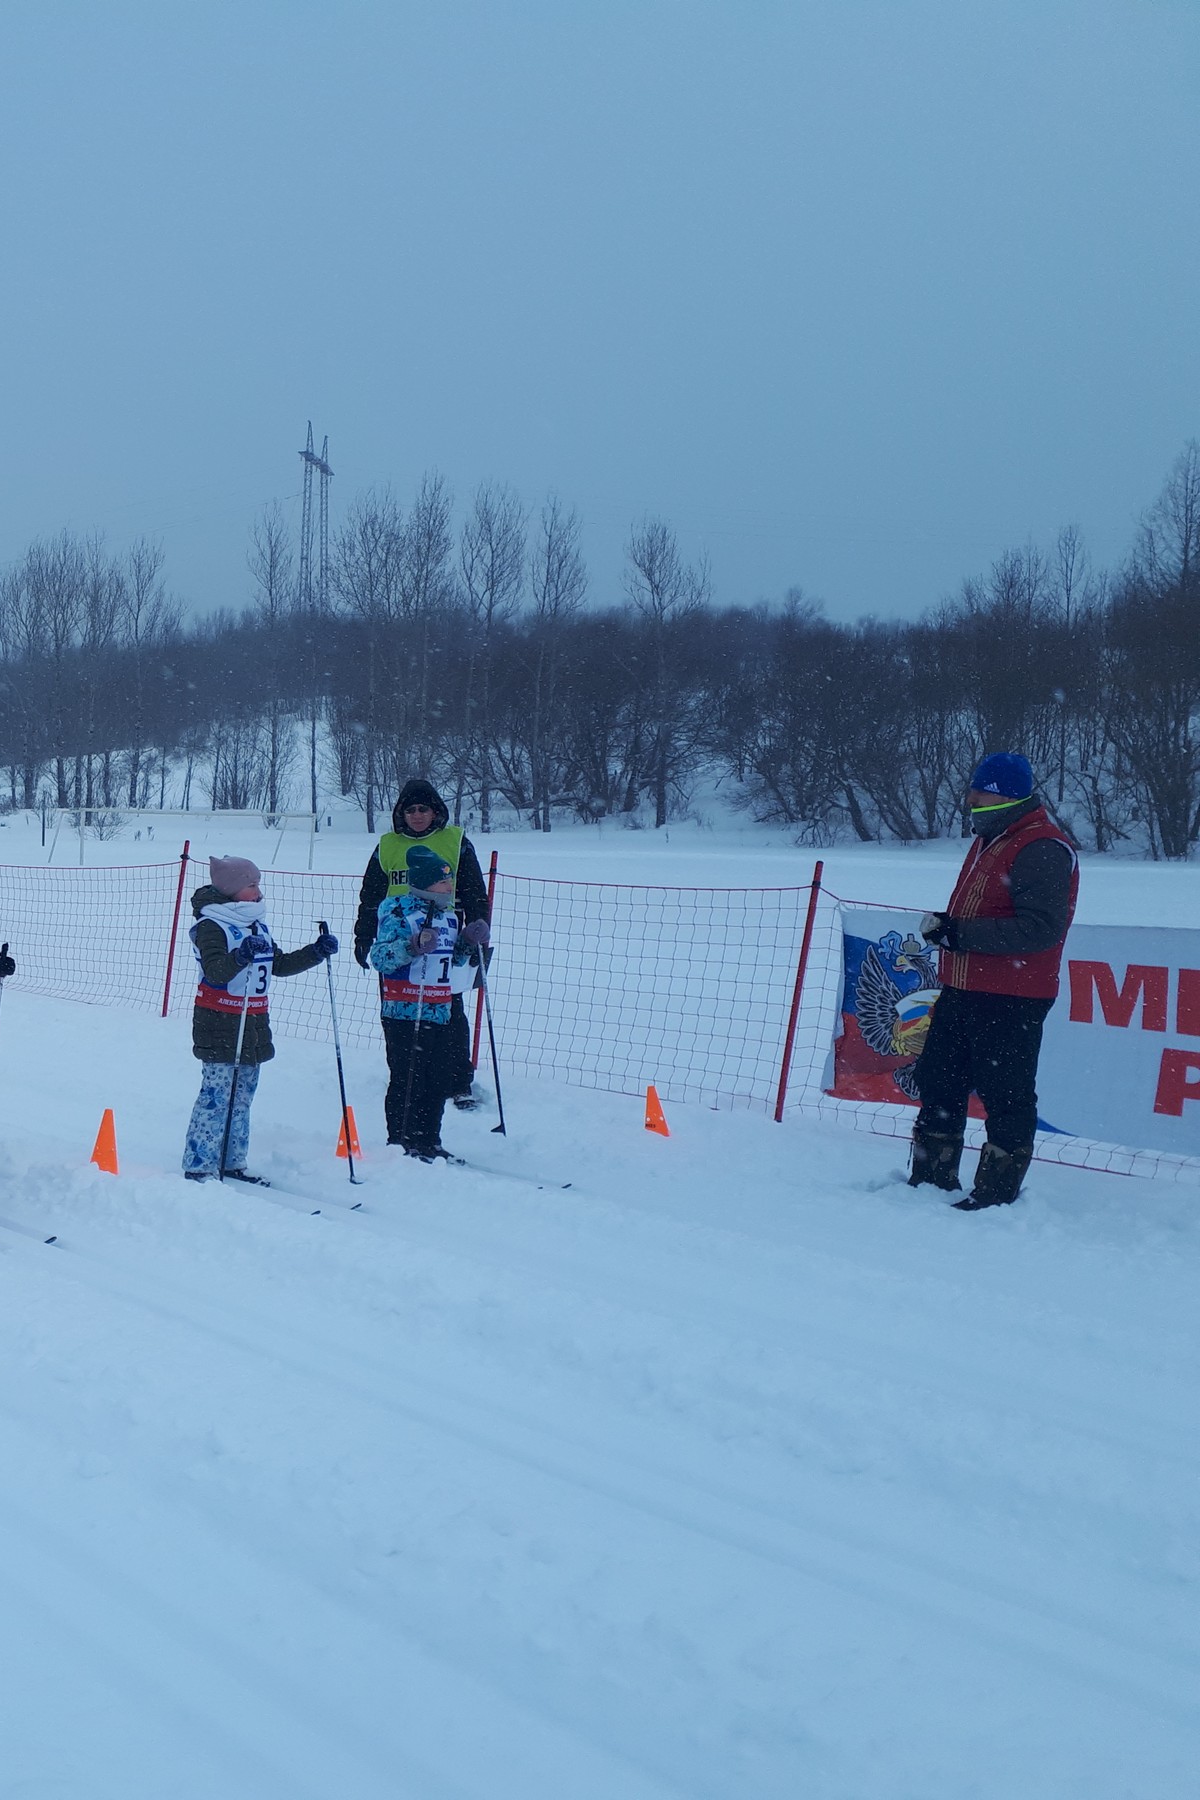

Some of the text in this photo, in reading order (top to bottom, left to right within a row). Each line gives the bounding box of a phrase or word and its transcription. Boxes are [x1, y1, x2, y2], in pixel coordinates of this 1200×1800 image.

[391, 869, 408, 886] RE
[255, 965, 268, 994] 3
[437, 956, 450, 984] 1
[1068, 960, 1200, 1036] М
